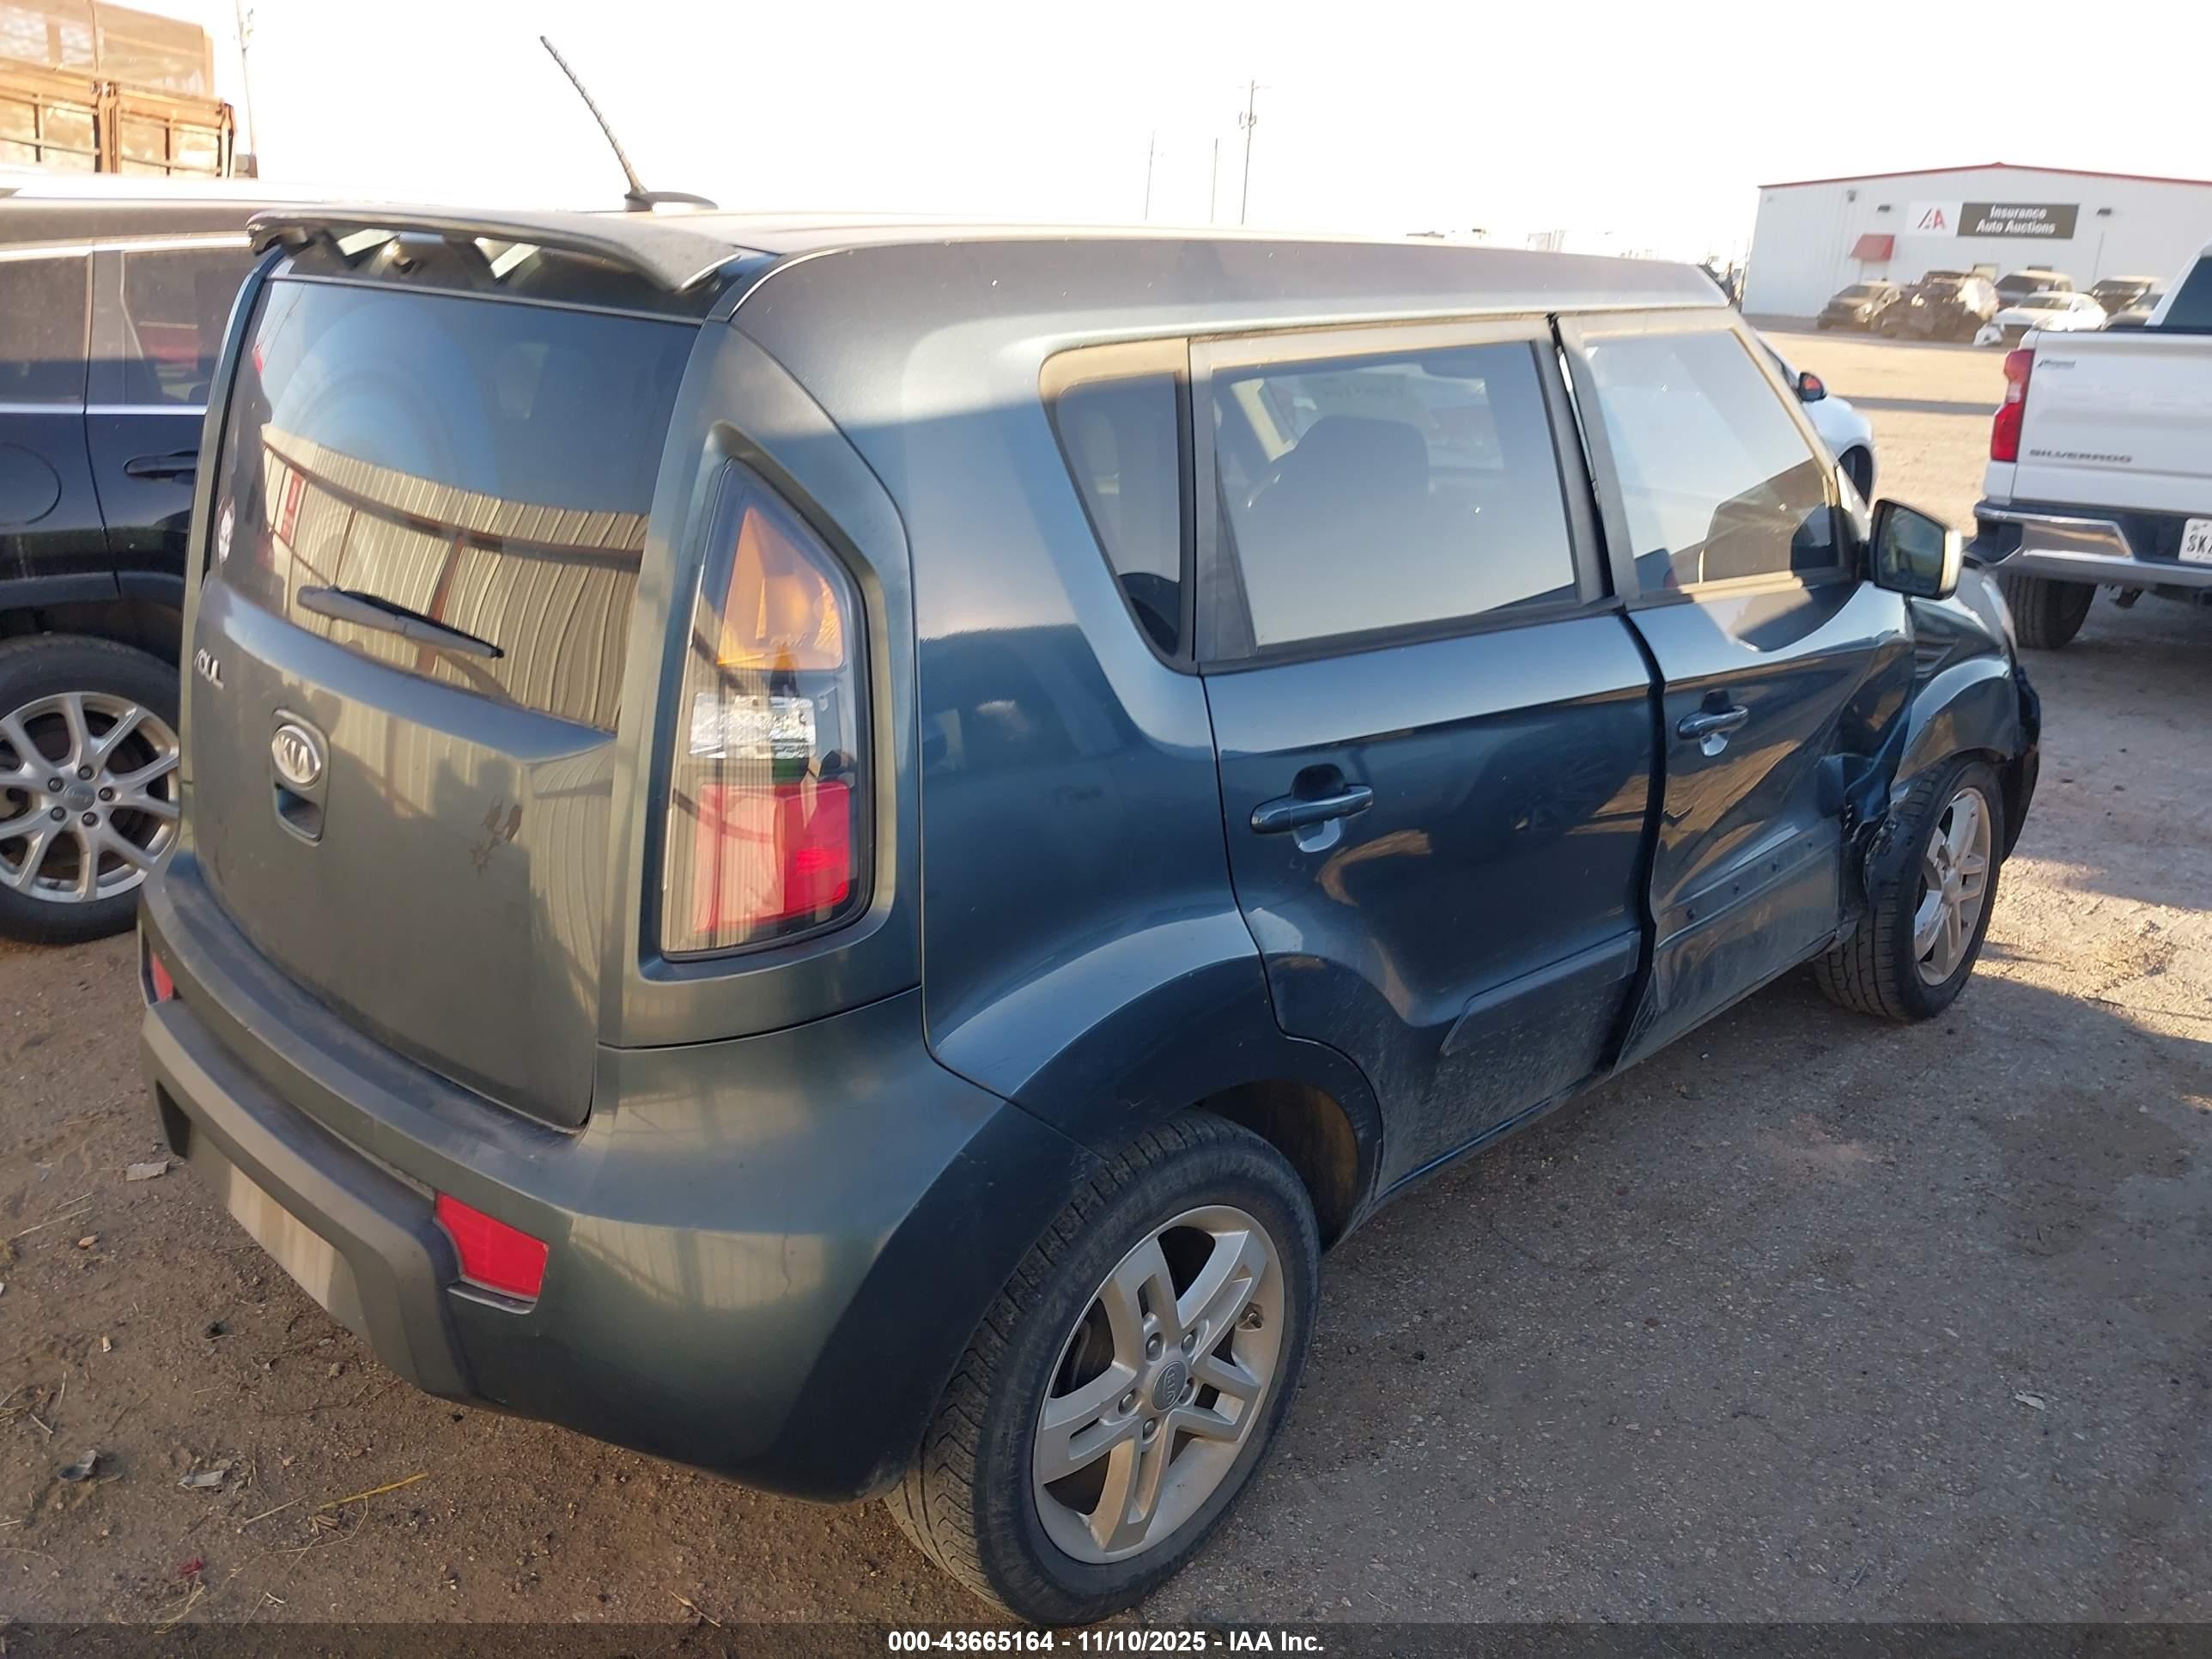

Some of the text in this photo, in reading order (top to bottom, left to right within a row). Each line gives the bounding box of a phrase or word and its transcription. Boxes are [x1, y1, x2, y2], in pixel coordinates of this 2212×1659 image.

[1990, 204, 2047, 220] Insurance
[1975, 218, 2056, 234] Auto Auctions
[2186, 533, 2212, 554] SK
[275, 732, 312, 781] KIA
